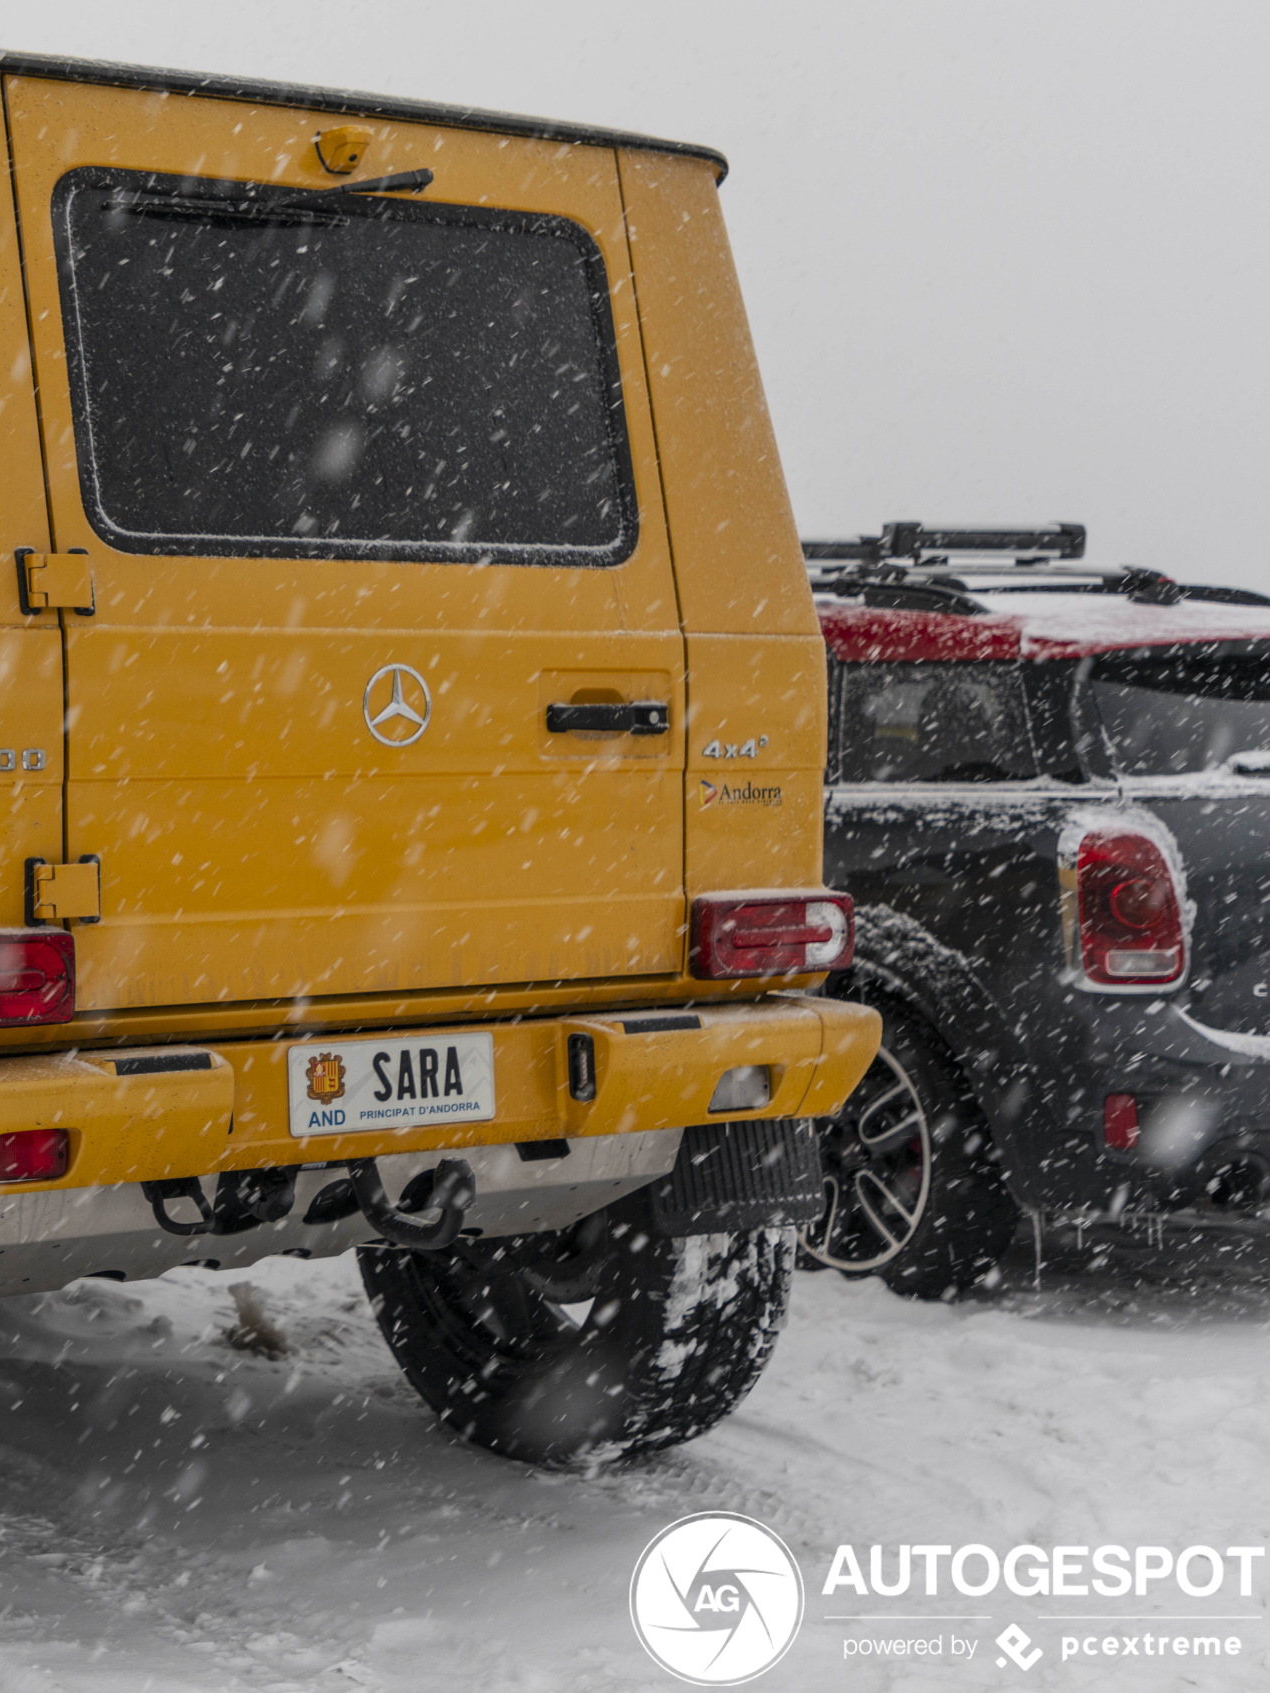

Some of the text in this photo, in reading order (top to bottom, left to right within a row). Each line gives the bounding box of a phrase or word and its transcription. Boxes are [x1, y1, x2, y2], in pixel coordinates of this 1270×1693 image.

[719, 781, 782, 801] Andorra
[372, 1046, 464, 1102] SARA
[308, 1109, 346, 1128] AND
[360, 1101, 480, 1120] PRINCIPAT D'ANDORRA
